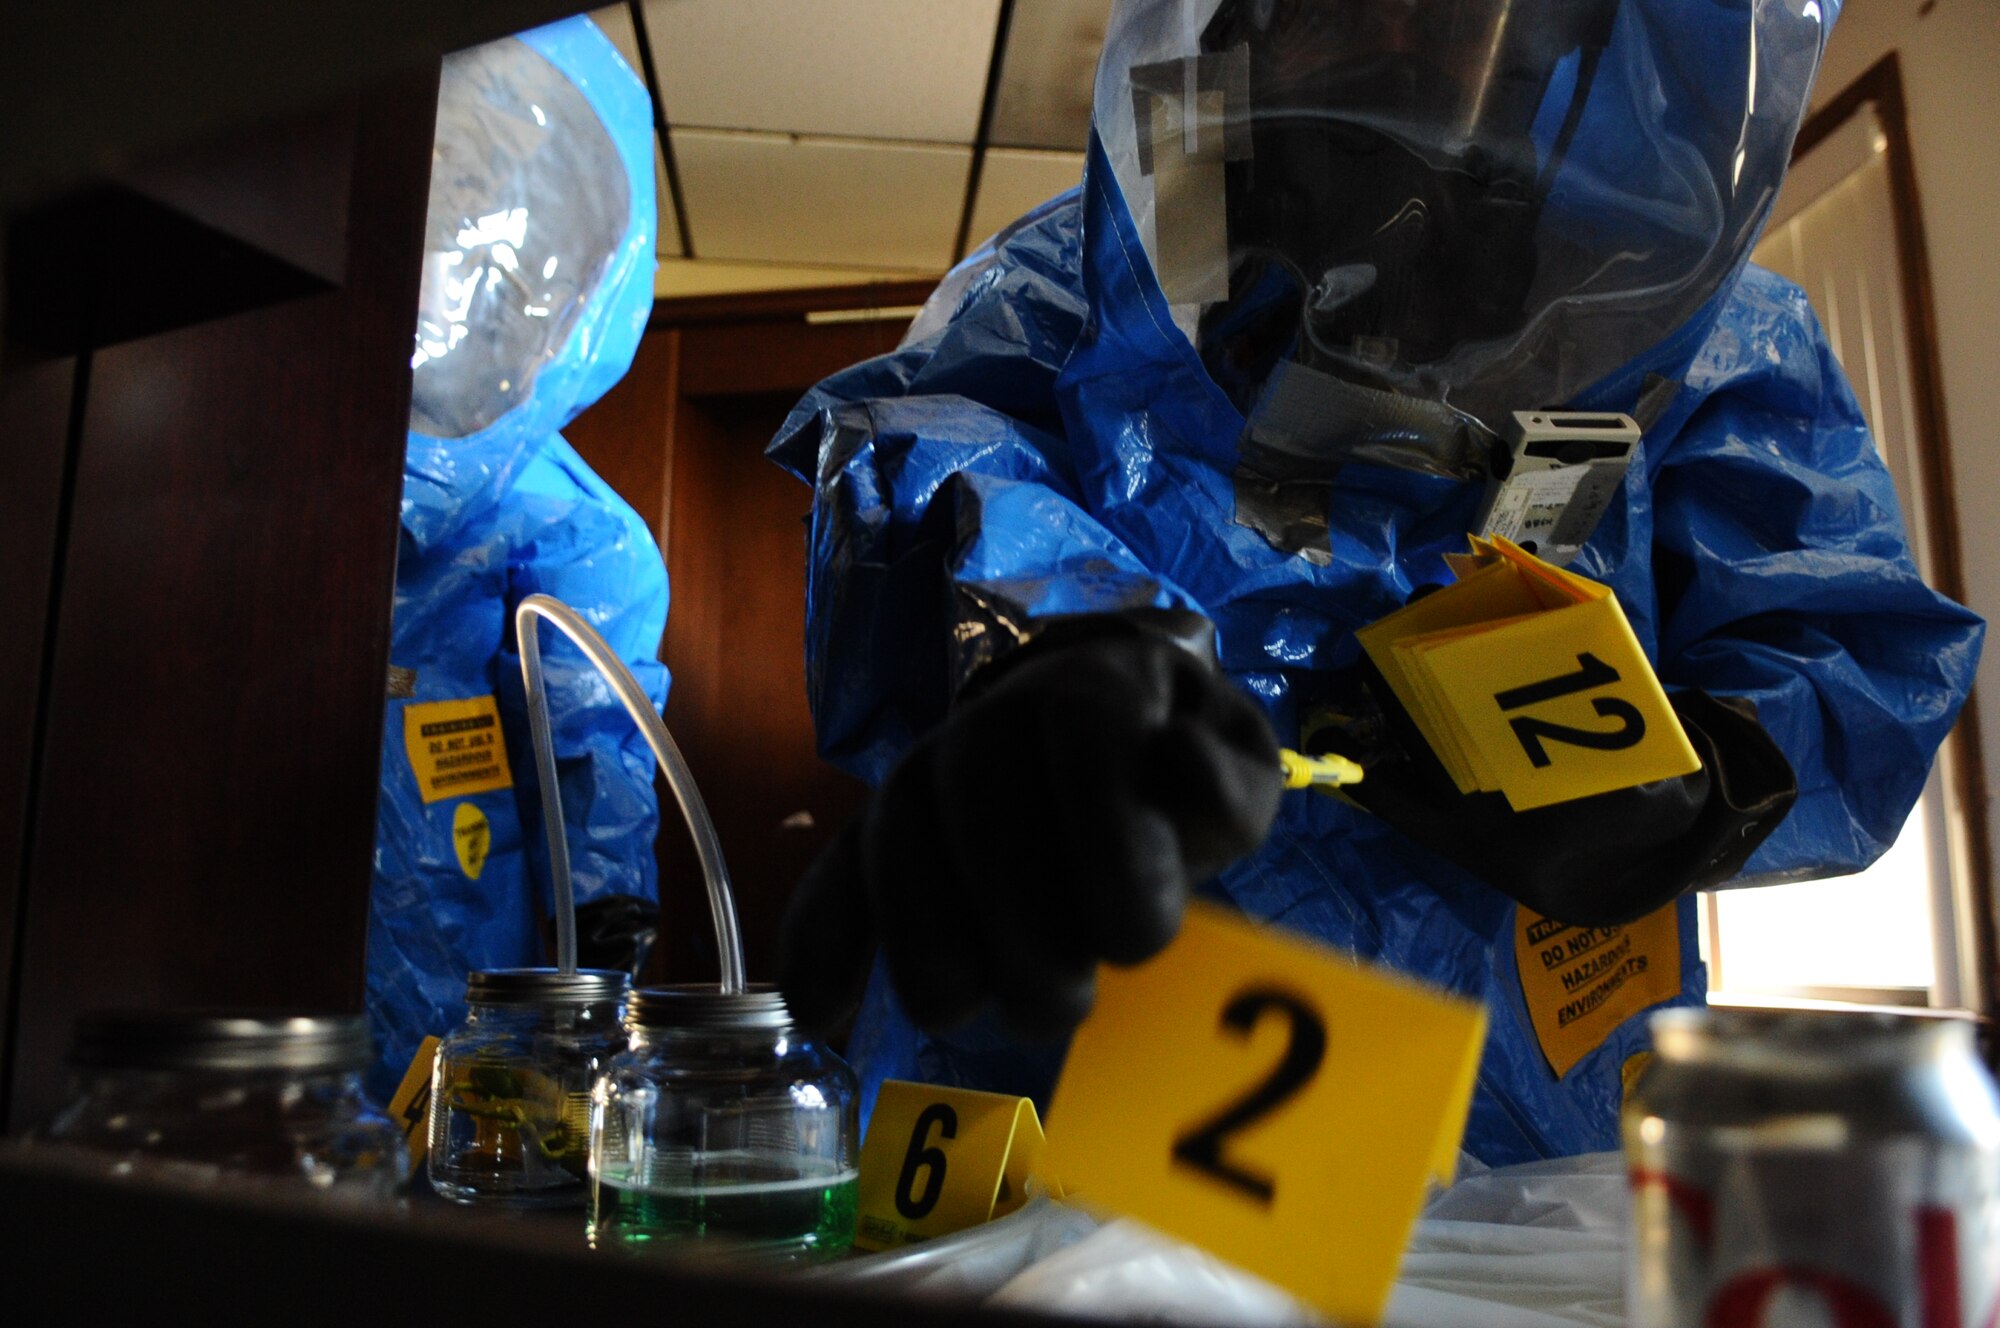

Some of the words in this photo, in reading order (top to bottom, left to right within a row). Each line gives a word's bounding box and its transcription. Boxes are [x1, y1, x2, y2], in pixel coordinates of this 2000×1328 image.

[1494, 652, 1646, 769] 12
[1529, 917, 1568, 943] TRA
[1541, 945, 1564, 968] DO
[1567, 930, 1597, 955] NOT
[1171, 979, 1328, 1213] 2
[895, 1103, 958, 1220] 6
